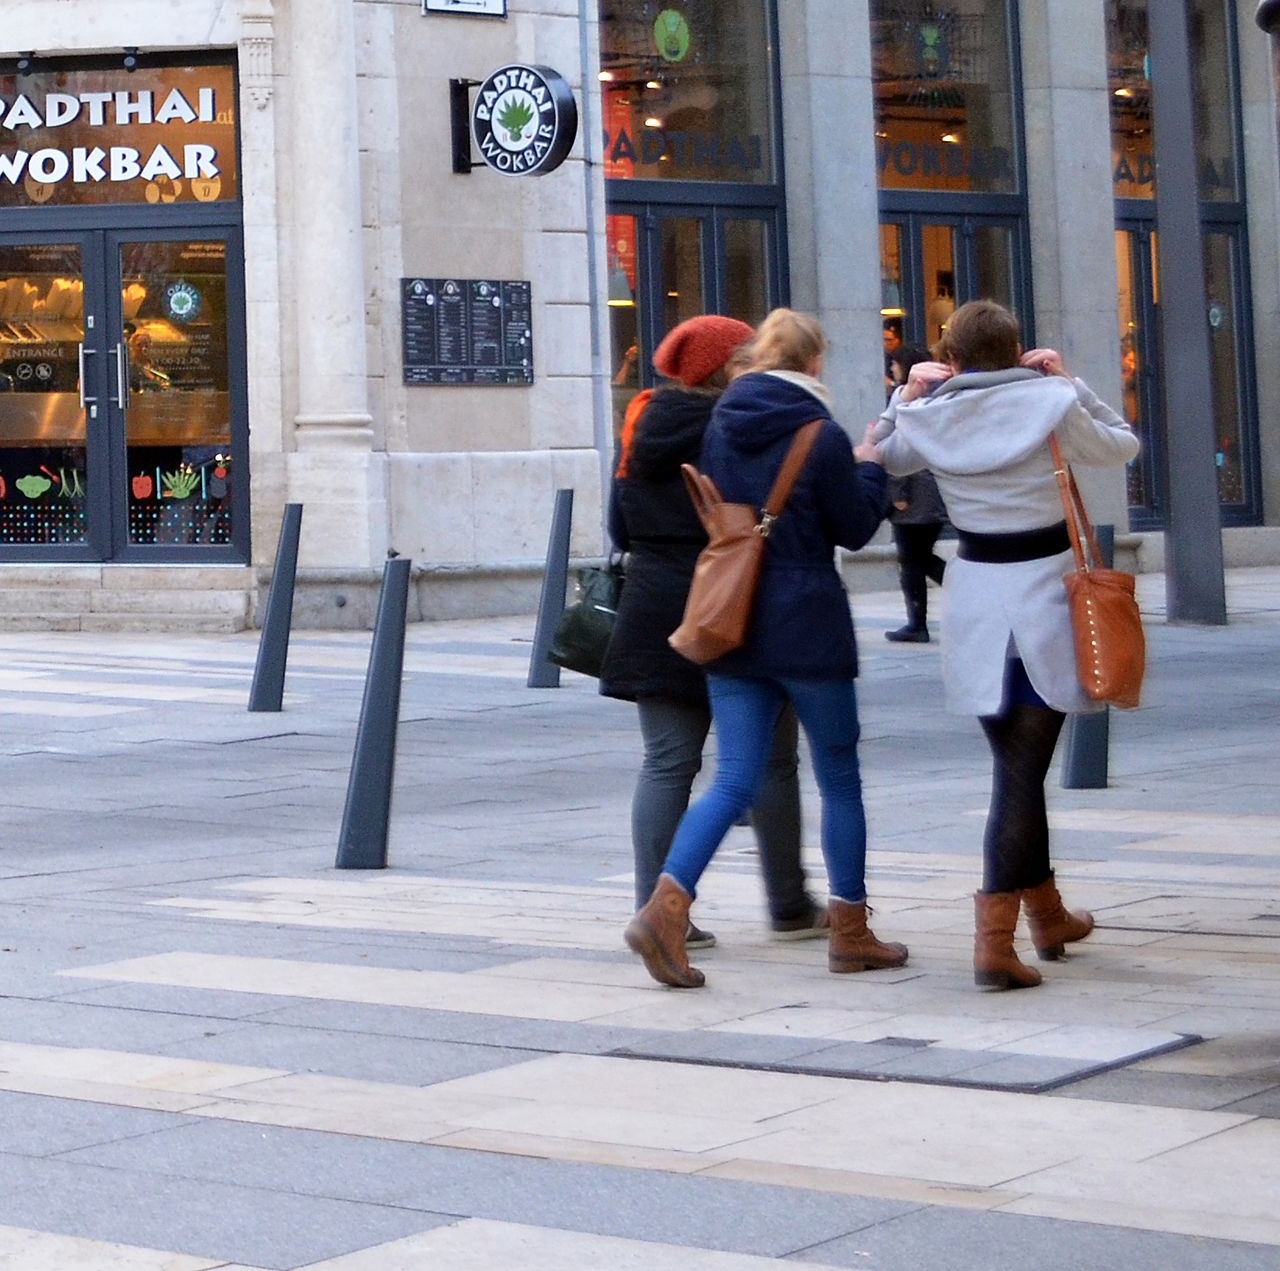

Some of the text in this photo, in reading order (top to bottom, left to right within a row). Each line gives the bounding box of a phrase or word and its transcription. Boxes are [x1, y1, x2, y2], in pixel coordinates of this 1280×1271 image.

[476, 69, 553, 121] PADTHAI
[481, 124, 553, 171] WOKBAR
[5, 347, 64, 359] ENTRANCE
